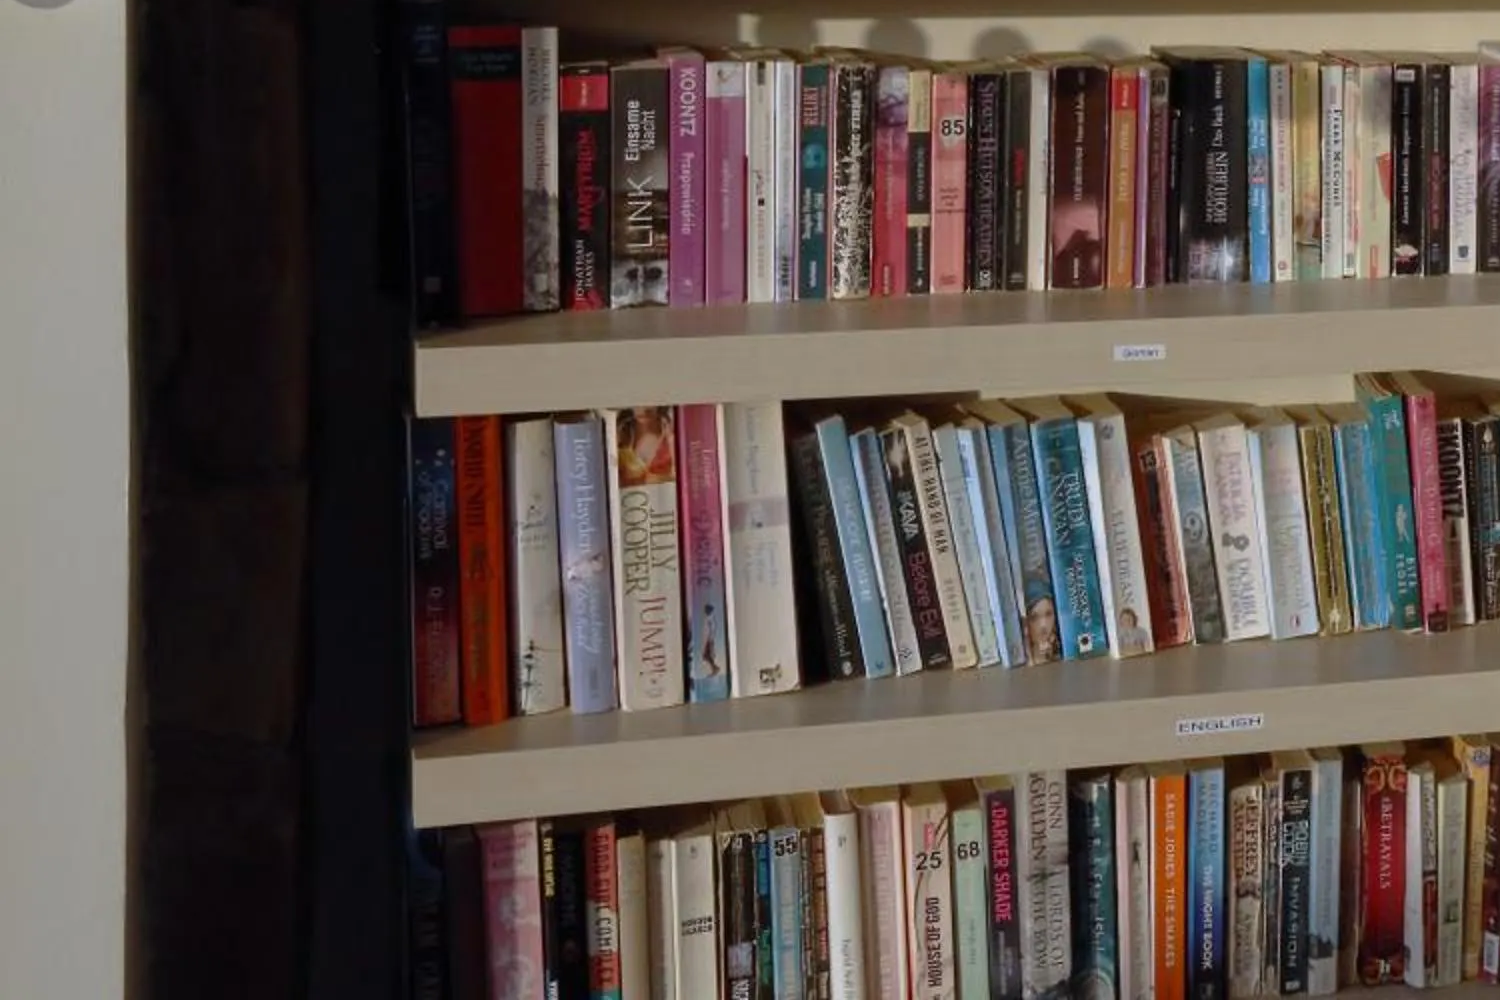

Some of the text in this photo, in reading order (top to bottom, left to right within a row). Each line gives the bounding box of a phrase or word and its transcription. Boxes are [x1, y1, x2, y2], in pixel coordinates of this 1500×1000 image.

[625, 100, 639, 161] Einsame
[639, 110, 655, 150] Nacht
[680, 67, 696, 136] KOONTZ
[941, 119, 964, 137] 85
[576, 127, 593, 232] MARTYRIUM
[625, 176, 653, 248] LINK
[575, 240, 585, 300] JONATHAN
[584, 252, 594, 287] HAYES
[918, 453, 934, 474] THE
[921, 477, 942, 509] HAND
[1438, 435, 1464, 520] KOONTZ
[433, 477, 449, 549] Carnival
[575, 485, 596, 554] Hayden
[1012, 437, 1045, 573] Annie Murray
[1064, 471, 1087, 529] TRUDI
[620, 490, 650, 596] COOPER
[649, 509, 676, 571] JILLY
[898, 495, 941, 637] KAVA Before Evil
[932, 529, 949, 555] MAN
[1116, 558, 1134, 605] DEAN
[638, 595, 668, 677] JUMP!
[1178, 716, 1260, 732] ENGLISH
[1048, 783, 1063, 829] CONN
[774, 836, 798, 857] 55
[915, 851, 942, 870] 25
[957, 841, 980, 860] 68
[991, 808, 1009, 867] DARKER
[1165, 793, 1176, 879] SADIE JONES
[1282, 822, 1294, 868] COOK
[1293, 820, 1309, 867] ROBIN
[1380, 804, 1392, 890] BETRAYALS
[594, 833, 614, 985] GOOD GIRL COMPLEX
[994, 873, 1011, 922] SHADE
[1049, 886, 1064, 941] LORDS
[1203, 890, 1213, 930] NIGHT
[1287, 877, 1301, 967] INVASION
[925, 897, 942, 987] HOUSE OF GOD
[1165, 887, 1176, 968] THE SNAKES
[1203, 933, 1213, 969] BOOK
